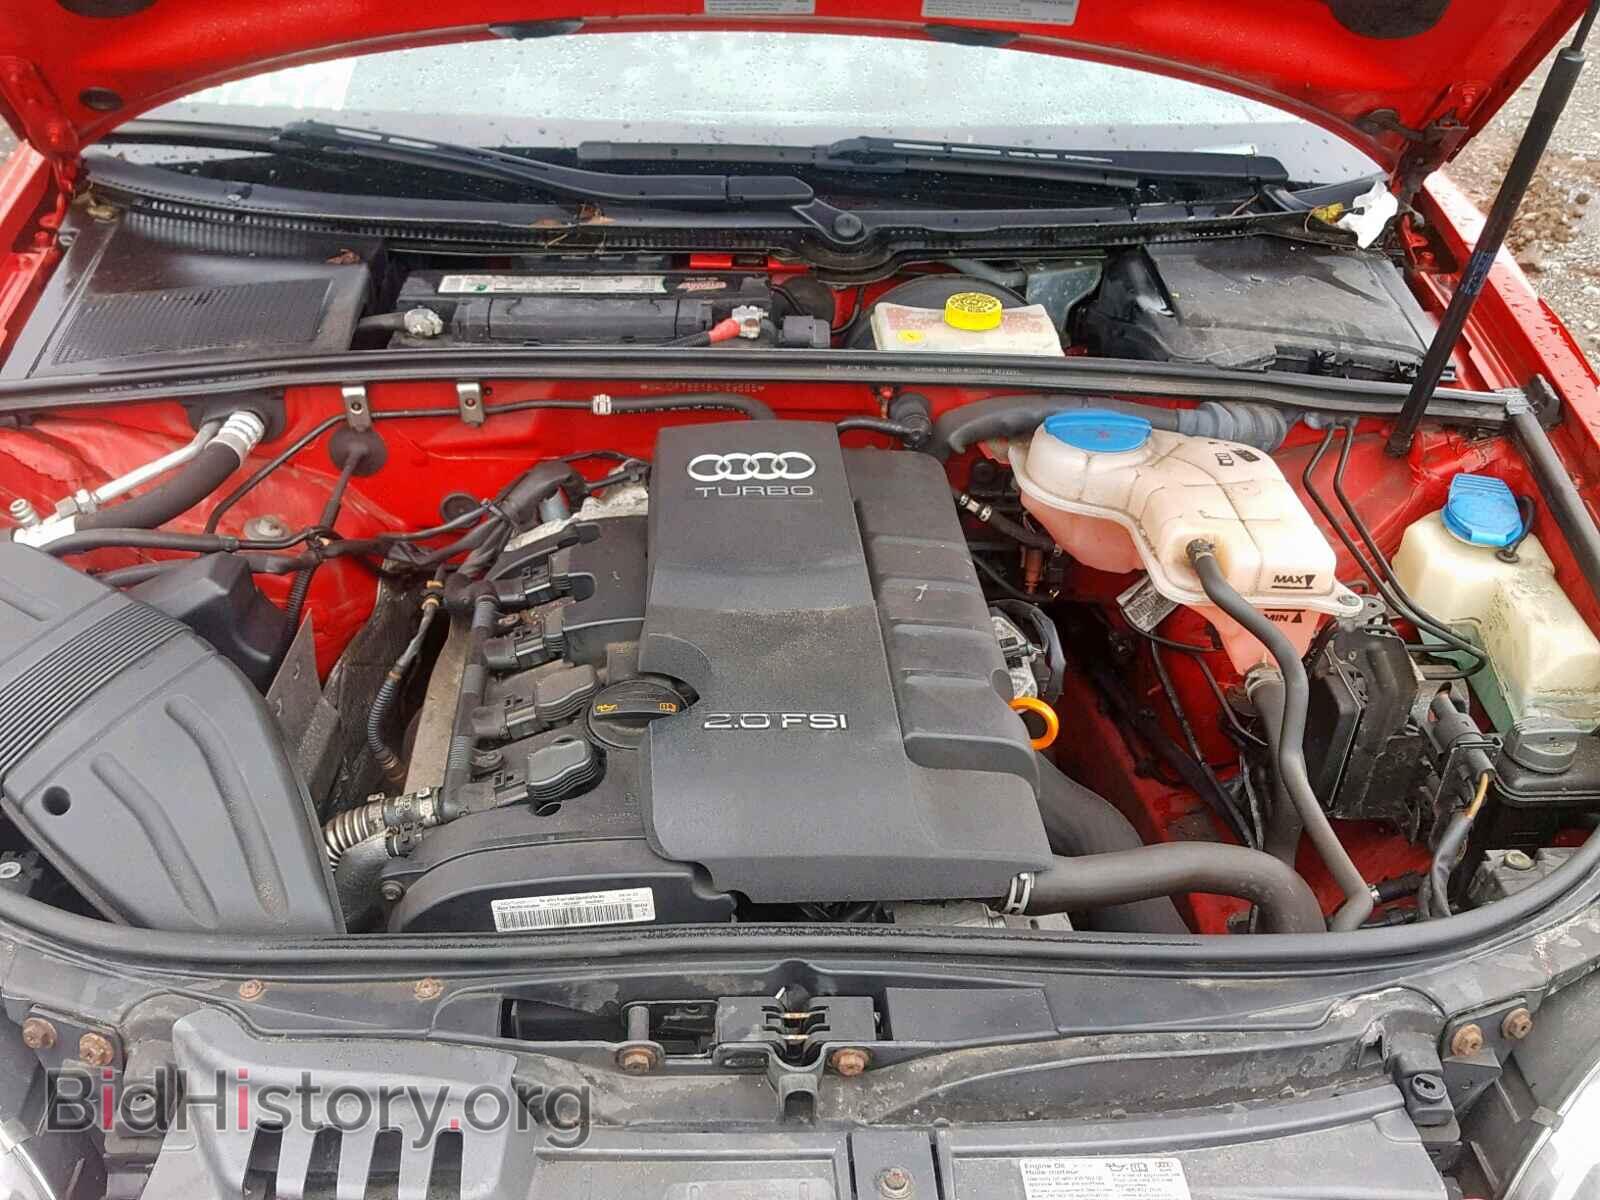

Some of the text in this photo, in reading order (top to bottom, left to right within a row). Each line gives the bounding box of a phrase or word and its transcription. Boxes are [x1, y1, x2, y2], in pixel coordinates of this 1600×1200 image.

[695, 486, 814, 497] TURBO
[1273, 574, 1304, 584] MAX
[704, 713, 847, 729] 2.0 FSI
